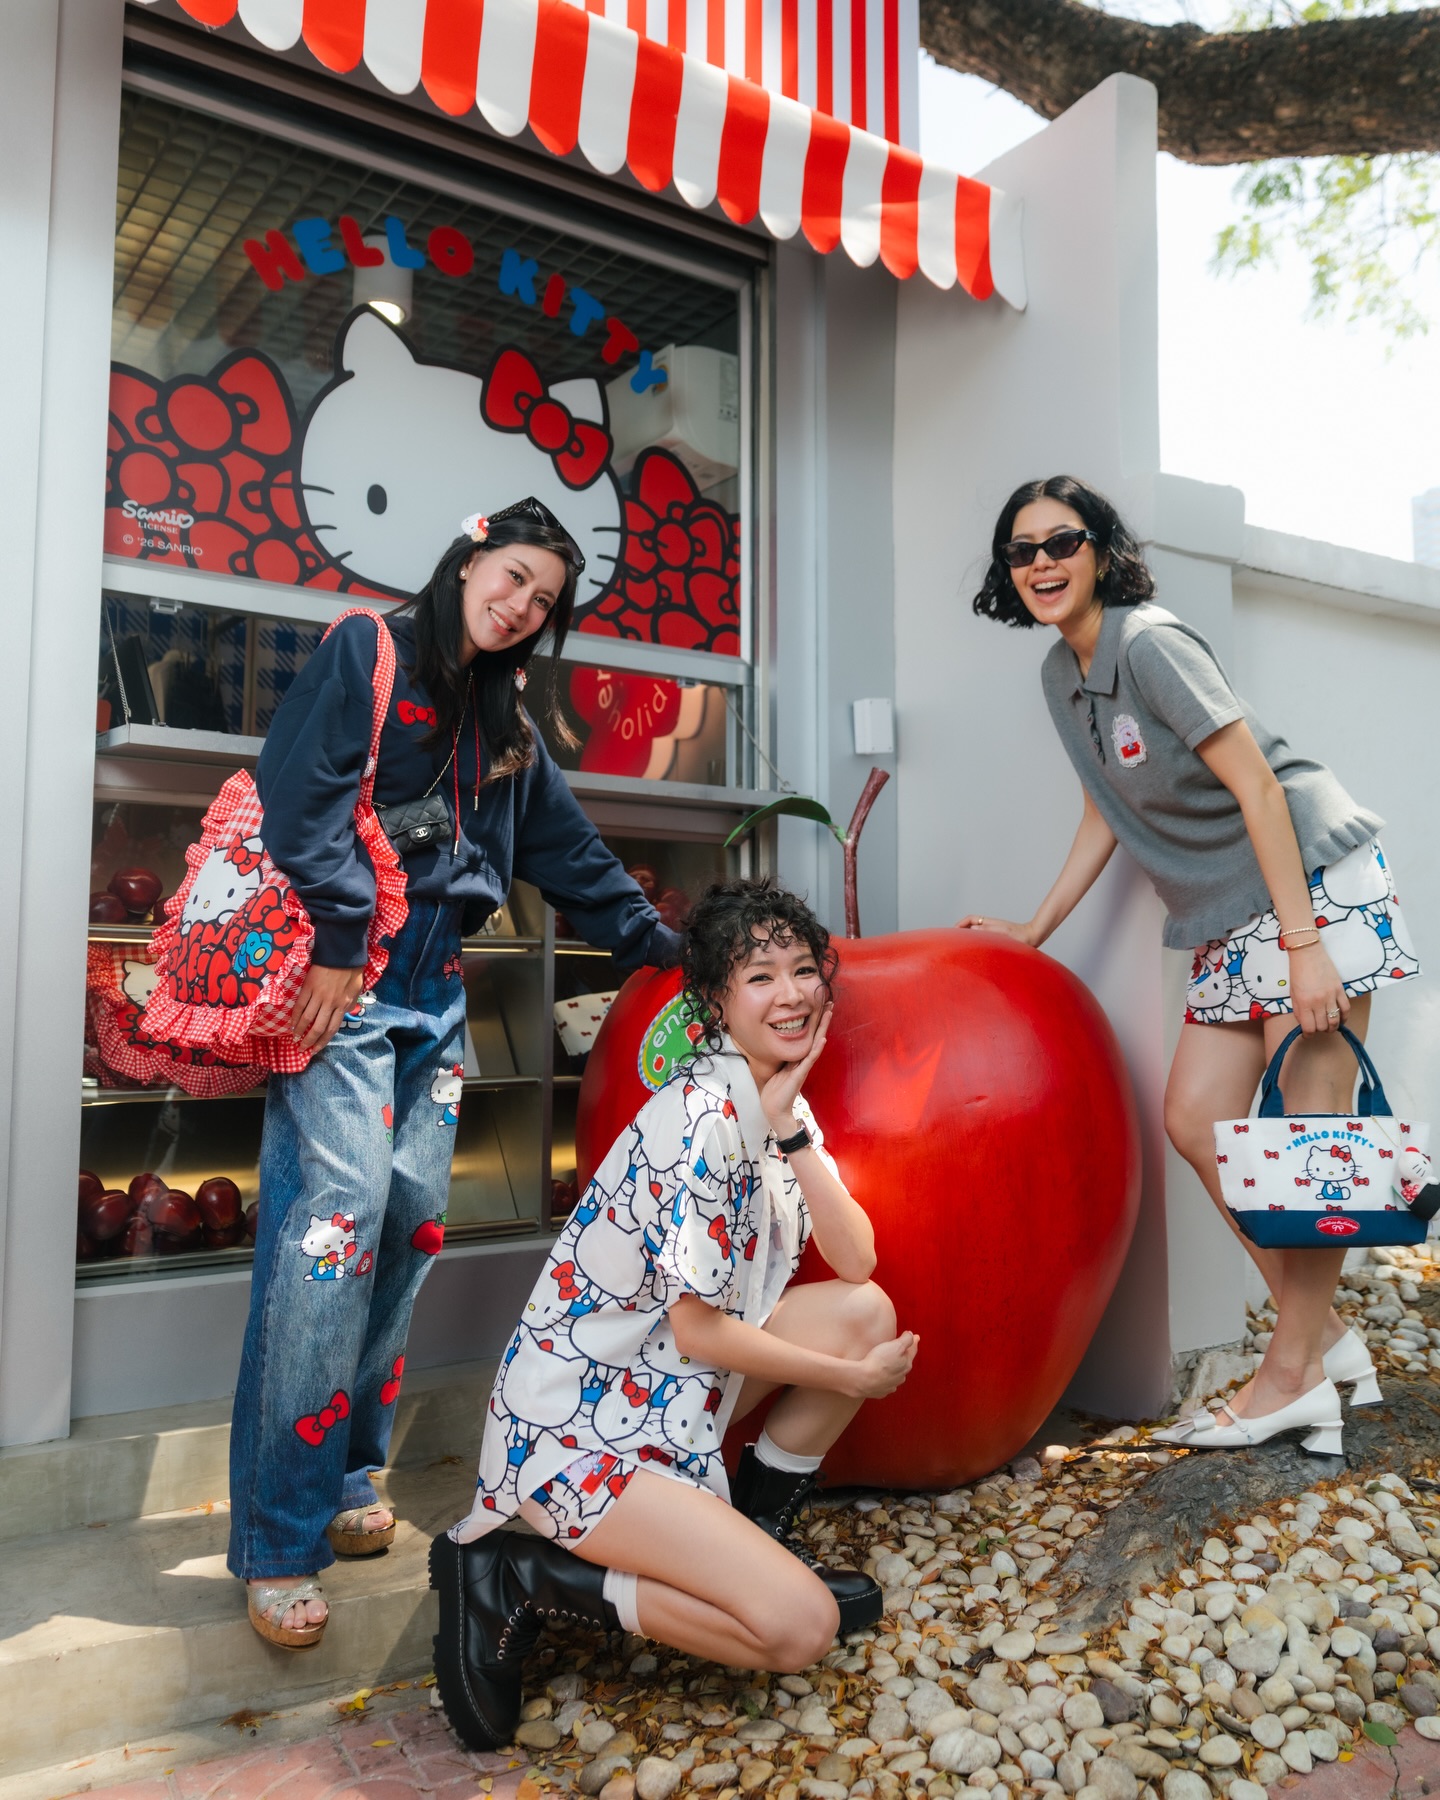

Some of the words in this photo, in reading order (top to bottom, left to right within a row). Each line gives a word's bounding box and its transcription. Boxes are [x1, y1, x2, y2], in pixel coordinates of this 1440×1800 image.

[243, 215, 475, 291] HELLO
[499, 248, 667, 393] KITTY
[122, 500, 194, 529] Sanrio
[138, 521, 178, 535] LICENSE
[157, 540, 203, 556] SANRIO
[608, 679, 671, 740] holid
[1292, 1131, 1329, 1147] HELLO
[1333, 1131, 1368, 1146] KITTY
